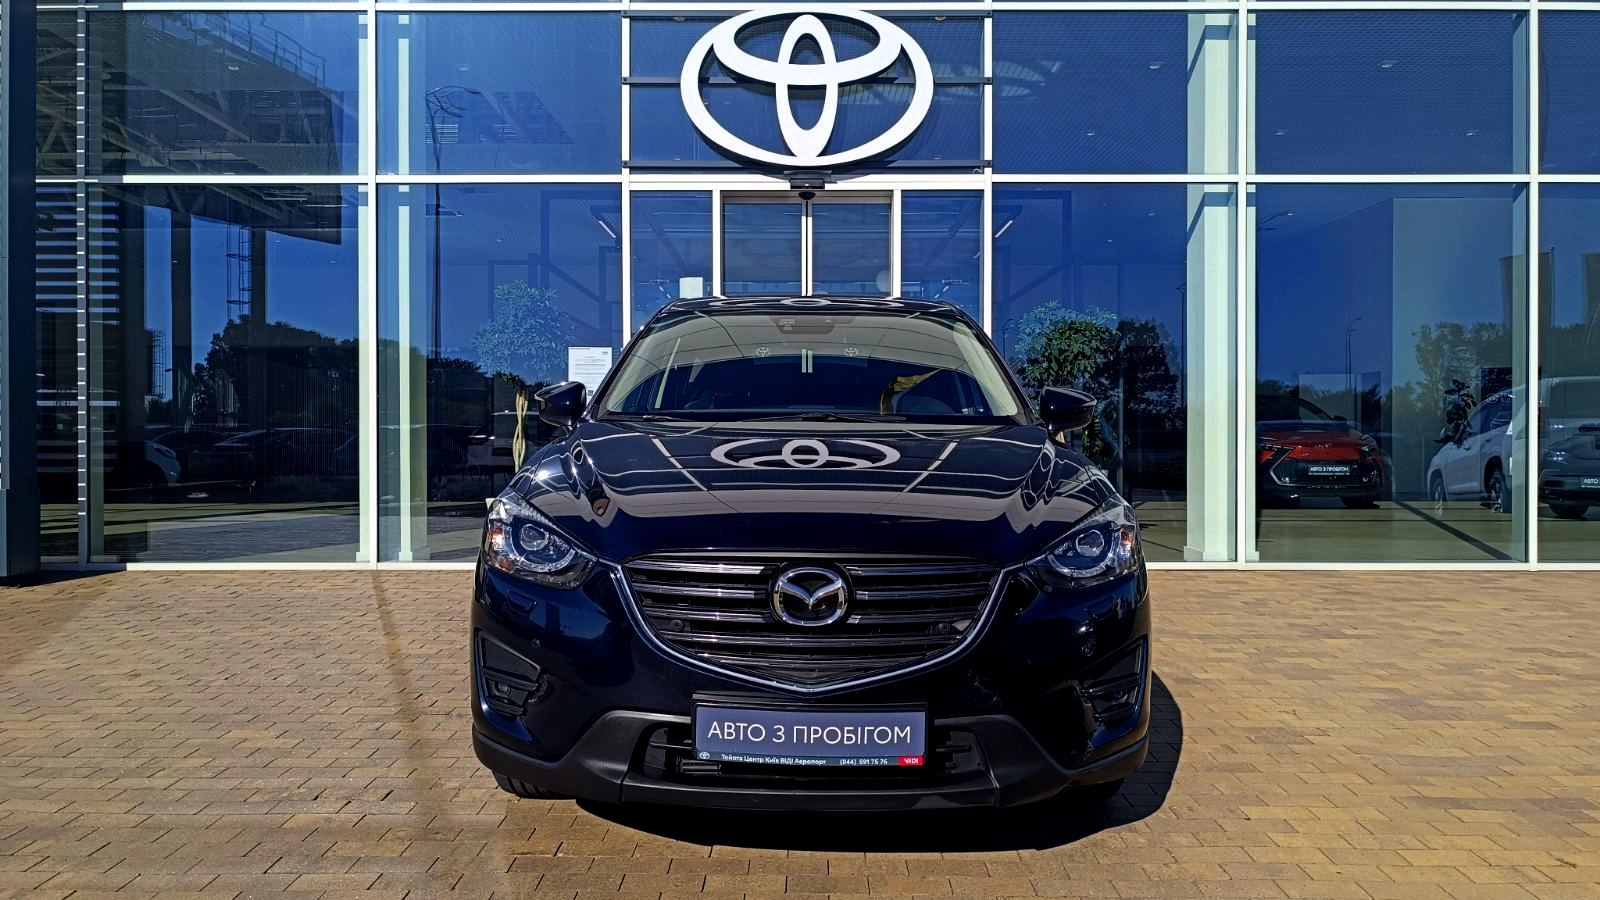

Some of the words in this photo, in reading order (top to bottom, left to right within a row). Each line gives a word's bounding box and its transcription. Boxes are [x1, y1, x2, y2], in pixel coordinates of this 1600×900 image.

[707, 721, 766, 742] АВТО
[772, 725, 785, 743] З
[793, 726, 911, 744] ПРОБІГОМ
[744, 755, 764, 763] Центр
[794, 758, 827, 766] Аеропорт
[839, 758, 857, 766] (044)
